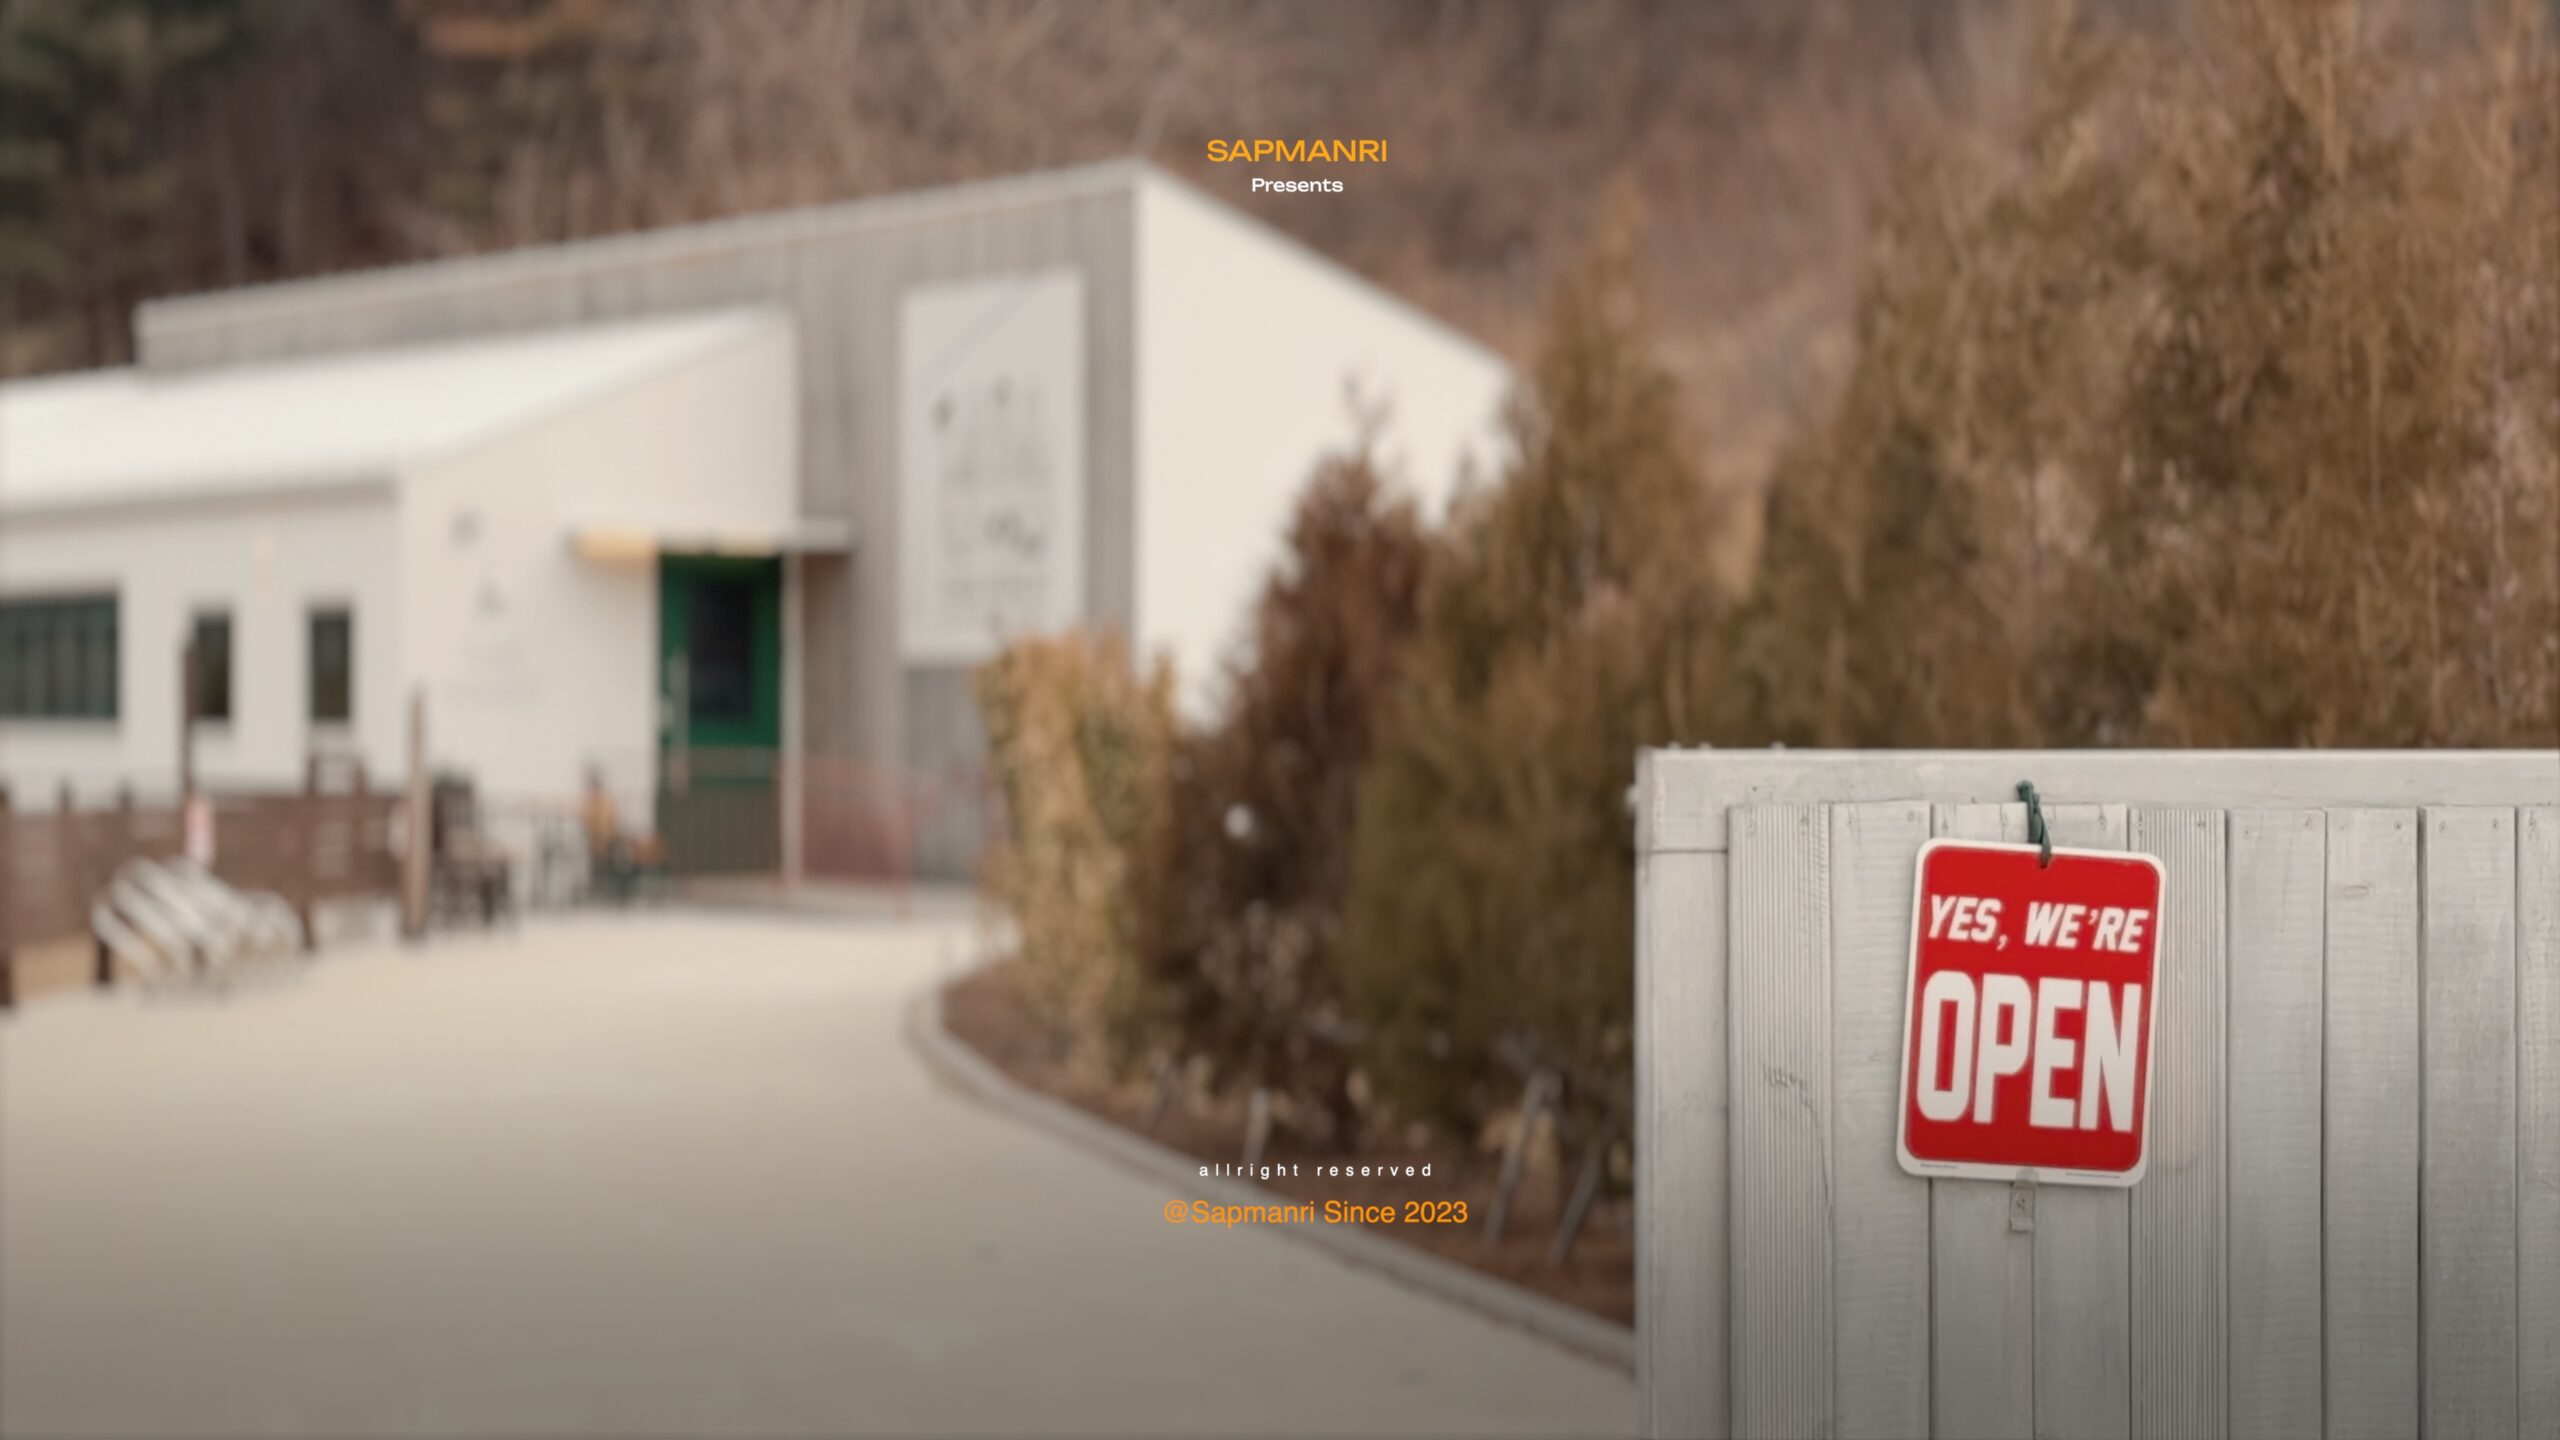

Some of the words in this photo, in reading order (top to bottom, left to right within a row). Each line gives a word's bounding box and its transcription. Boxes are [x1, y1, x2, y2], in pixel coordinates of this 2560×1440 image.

[1928, 894, 2008, 951] YES,
[2024, 901, 2150, 953] WE'RE
[1917, 970, 2142, 1132] OPEN
